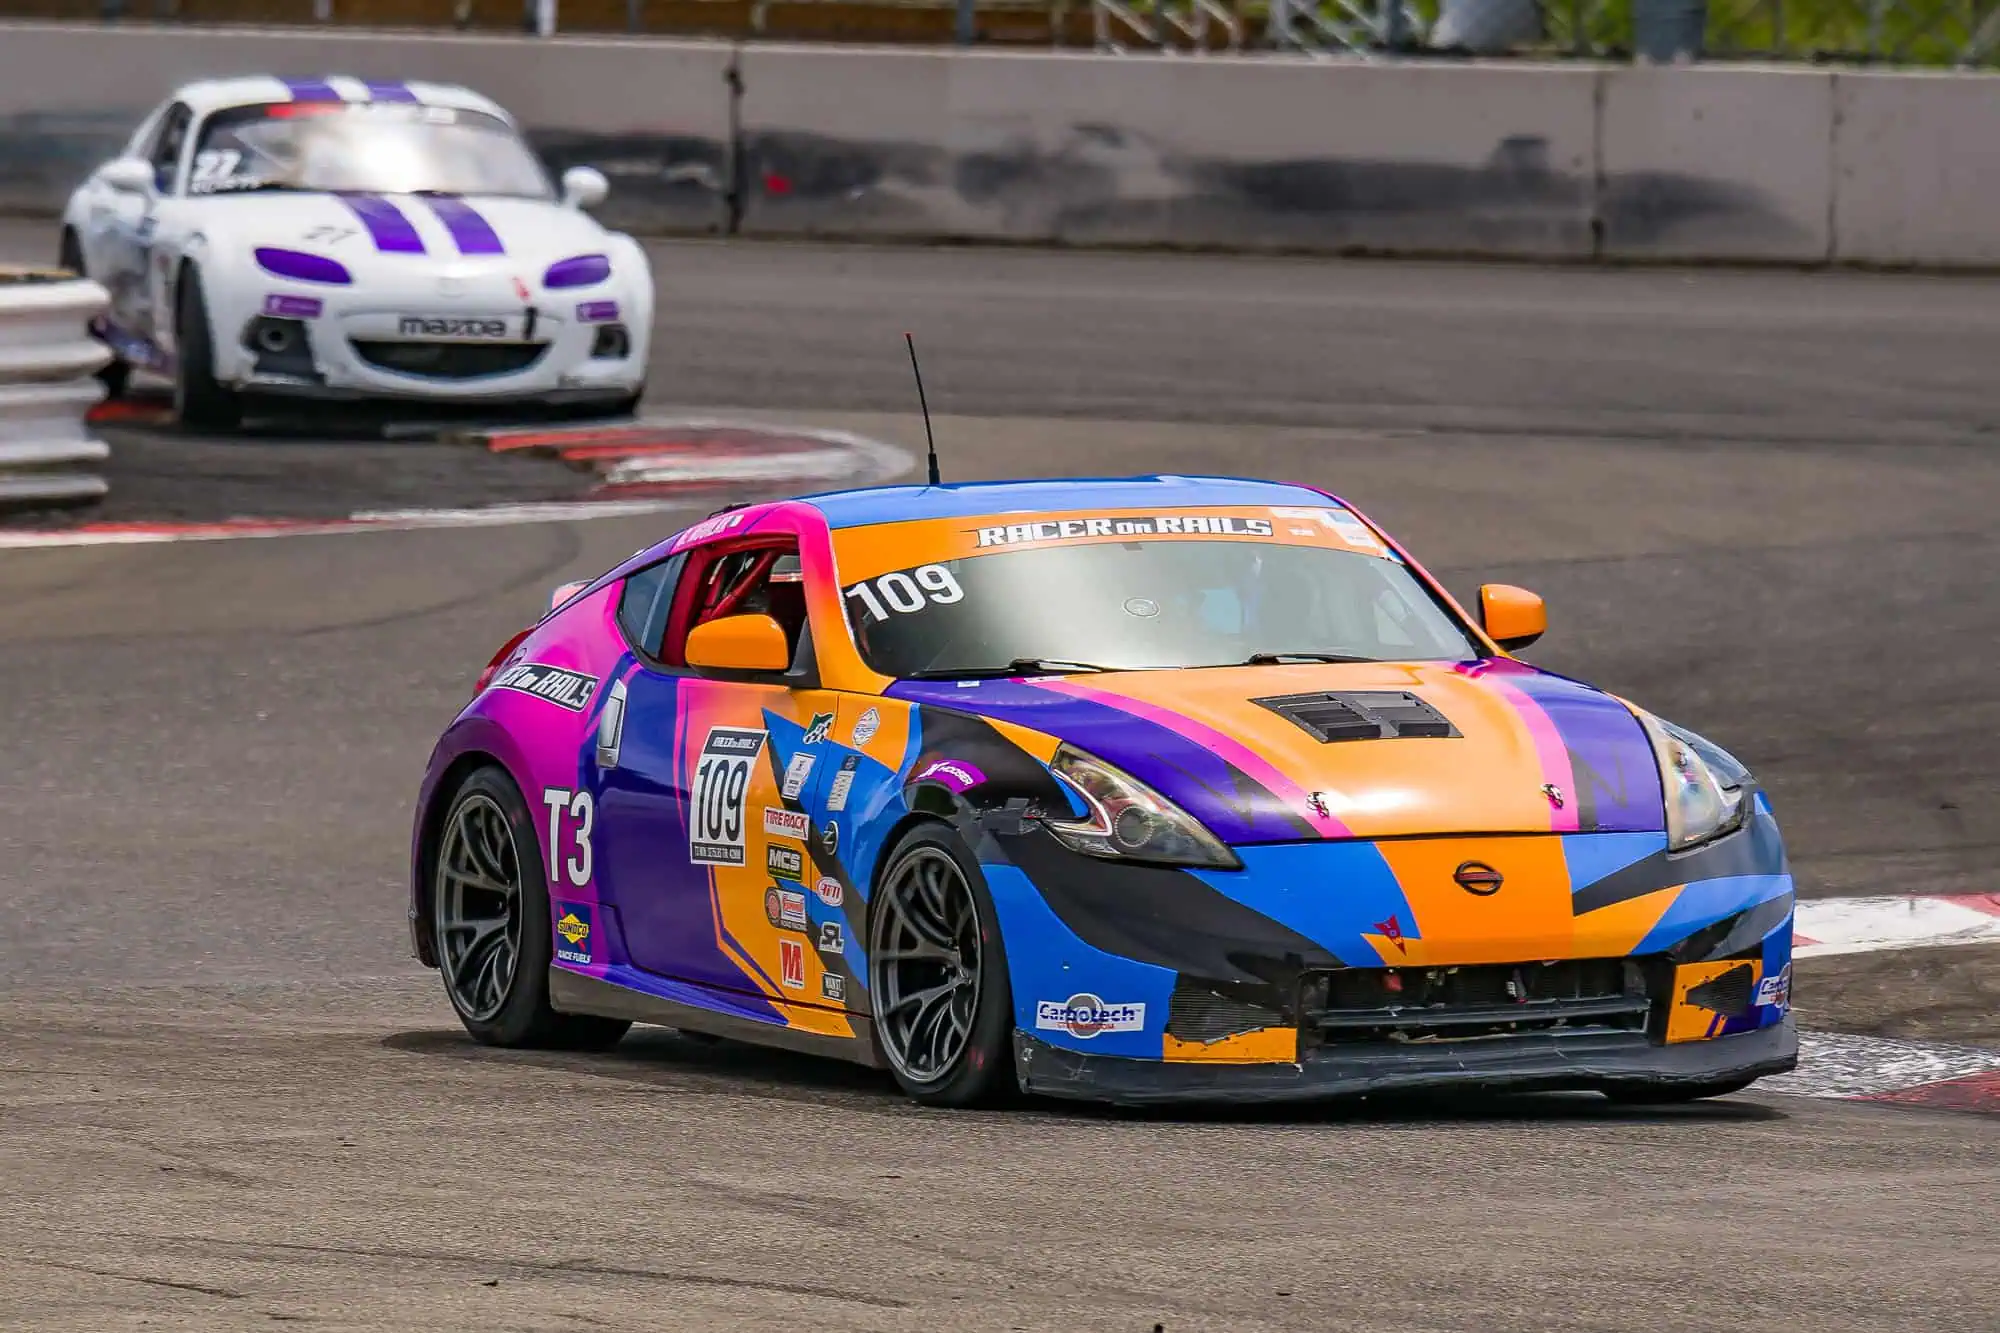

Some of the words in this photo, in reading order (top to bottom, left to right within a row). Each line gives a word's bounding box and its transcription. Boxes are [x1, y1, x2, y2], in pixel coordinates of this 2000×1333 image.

[978, 519, 1113, 548] RACER
[1116, 521, 1152, 536] on
[1155, 516, 1274, 538] RAILS
[847, 565, 965, 623] 109
[531, 671, 596, 708] RAILS
[698, 759, 748, 842] 109
[543, 788, 594, 888] T3
[765, 810, 785, 826] TIRE
[784, 813, 808, 840] RACK
[768, 848, 801, 872] MCS
[558, 922, 588, 938] SUNOCO
